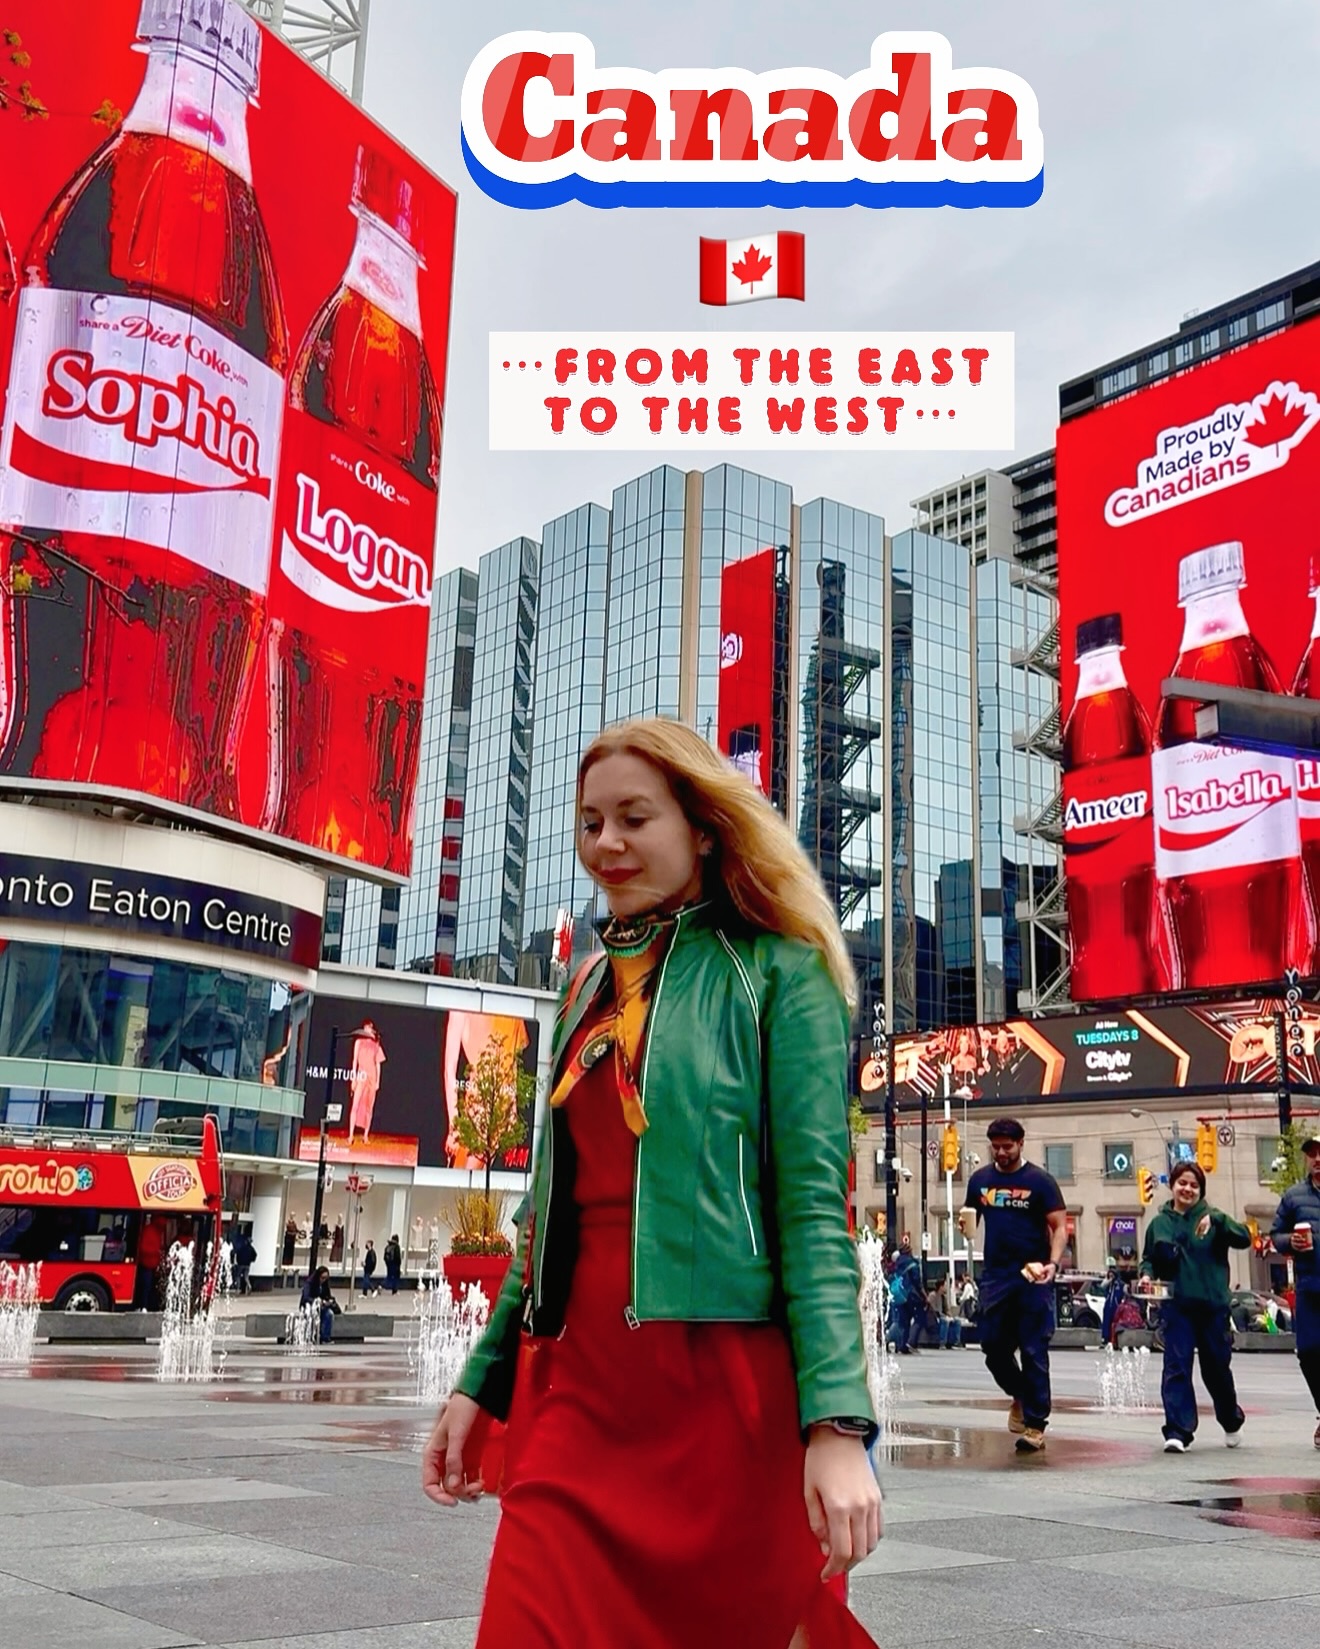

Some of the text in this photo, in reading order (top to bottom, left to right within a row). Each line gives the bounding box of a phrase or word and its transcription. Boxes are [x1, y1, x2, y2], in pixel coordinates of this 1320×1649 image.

[79, 318, 110, 331] share
[112, 323, 120, 331] a
[120, 315, 182, 349] Diet
[43, 349, 260, 479] Sophia
[1163, 410, 1245, 454] Proudly
[354, 460, 396, 502] Coke
[1145, 436, 1236, 483] Made by
[1111, 453, 1251, 518] Canadians
[297, 473, 432, 605] Logan
[1065, 790, 1147, 829] Ameer
[1166, 770, 1283, 819] Isabella
[88, 878, 192, 926] Eaton
[202, 897, 292, 947] Centre
[1076, 1029, 1139, 1046] TUESDAYS 8
[306, 1065, 328, 1079] H&M
[1085, 1050, 1132, 1071] Citytv
[148, 1175, 197, 1196] OFFICIAL
